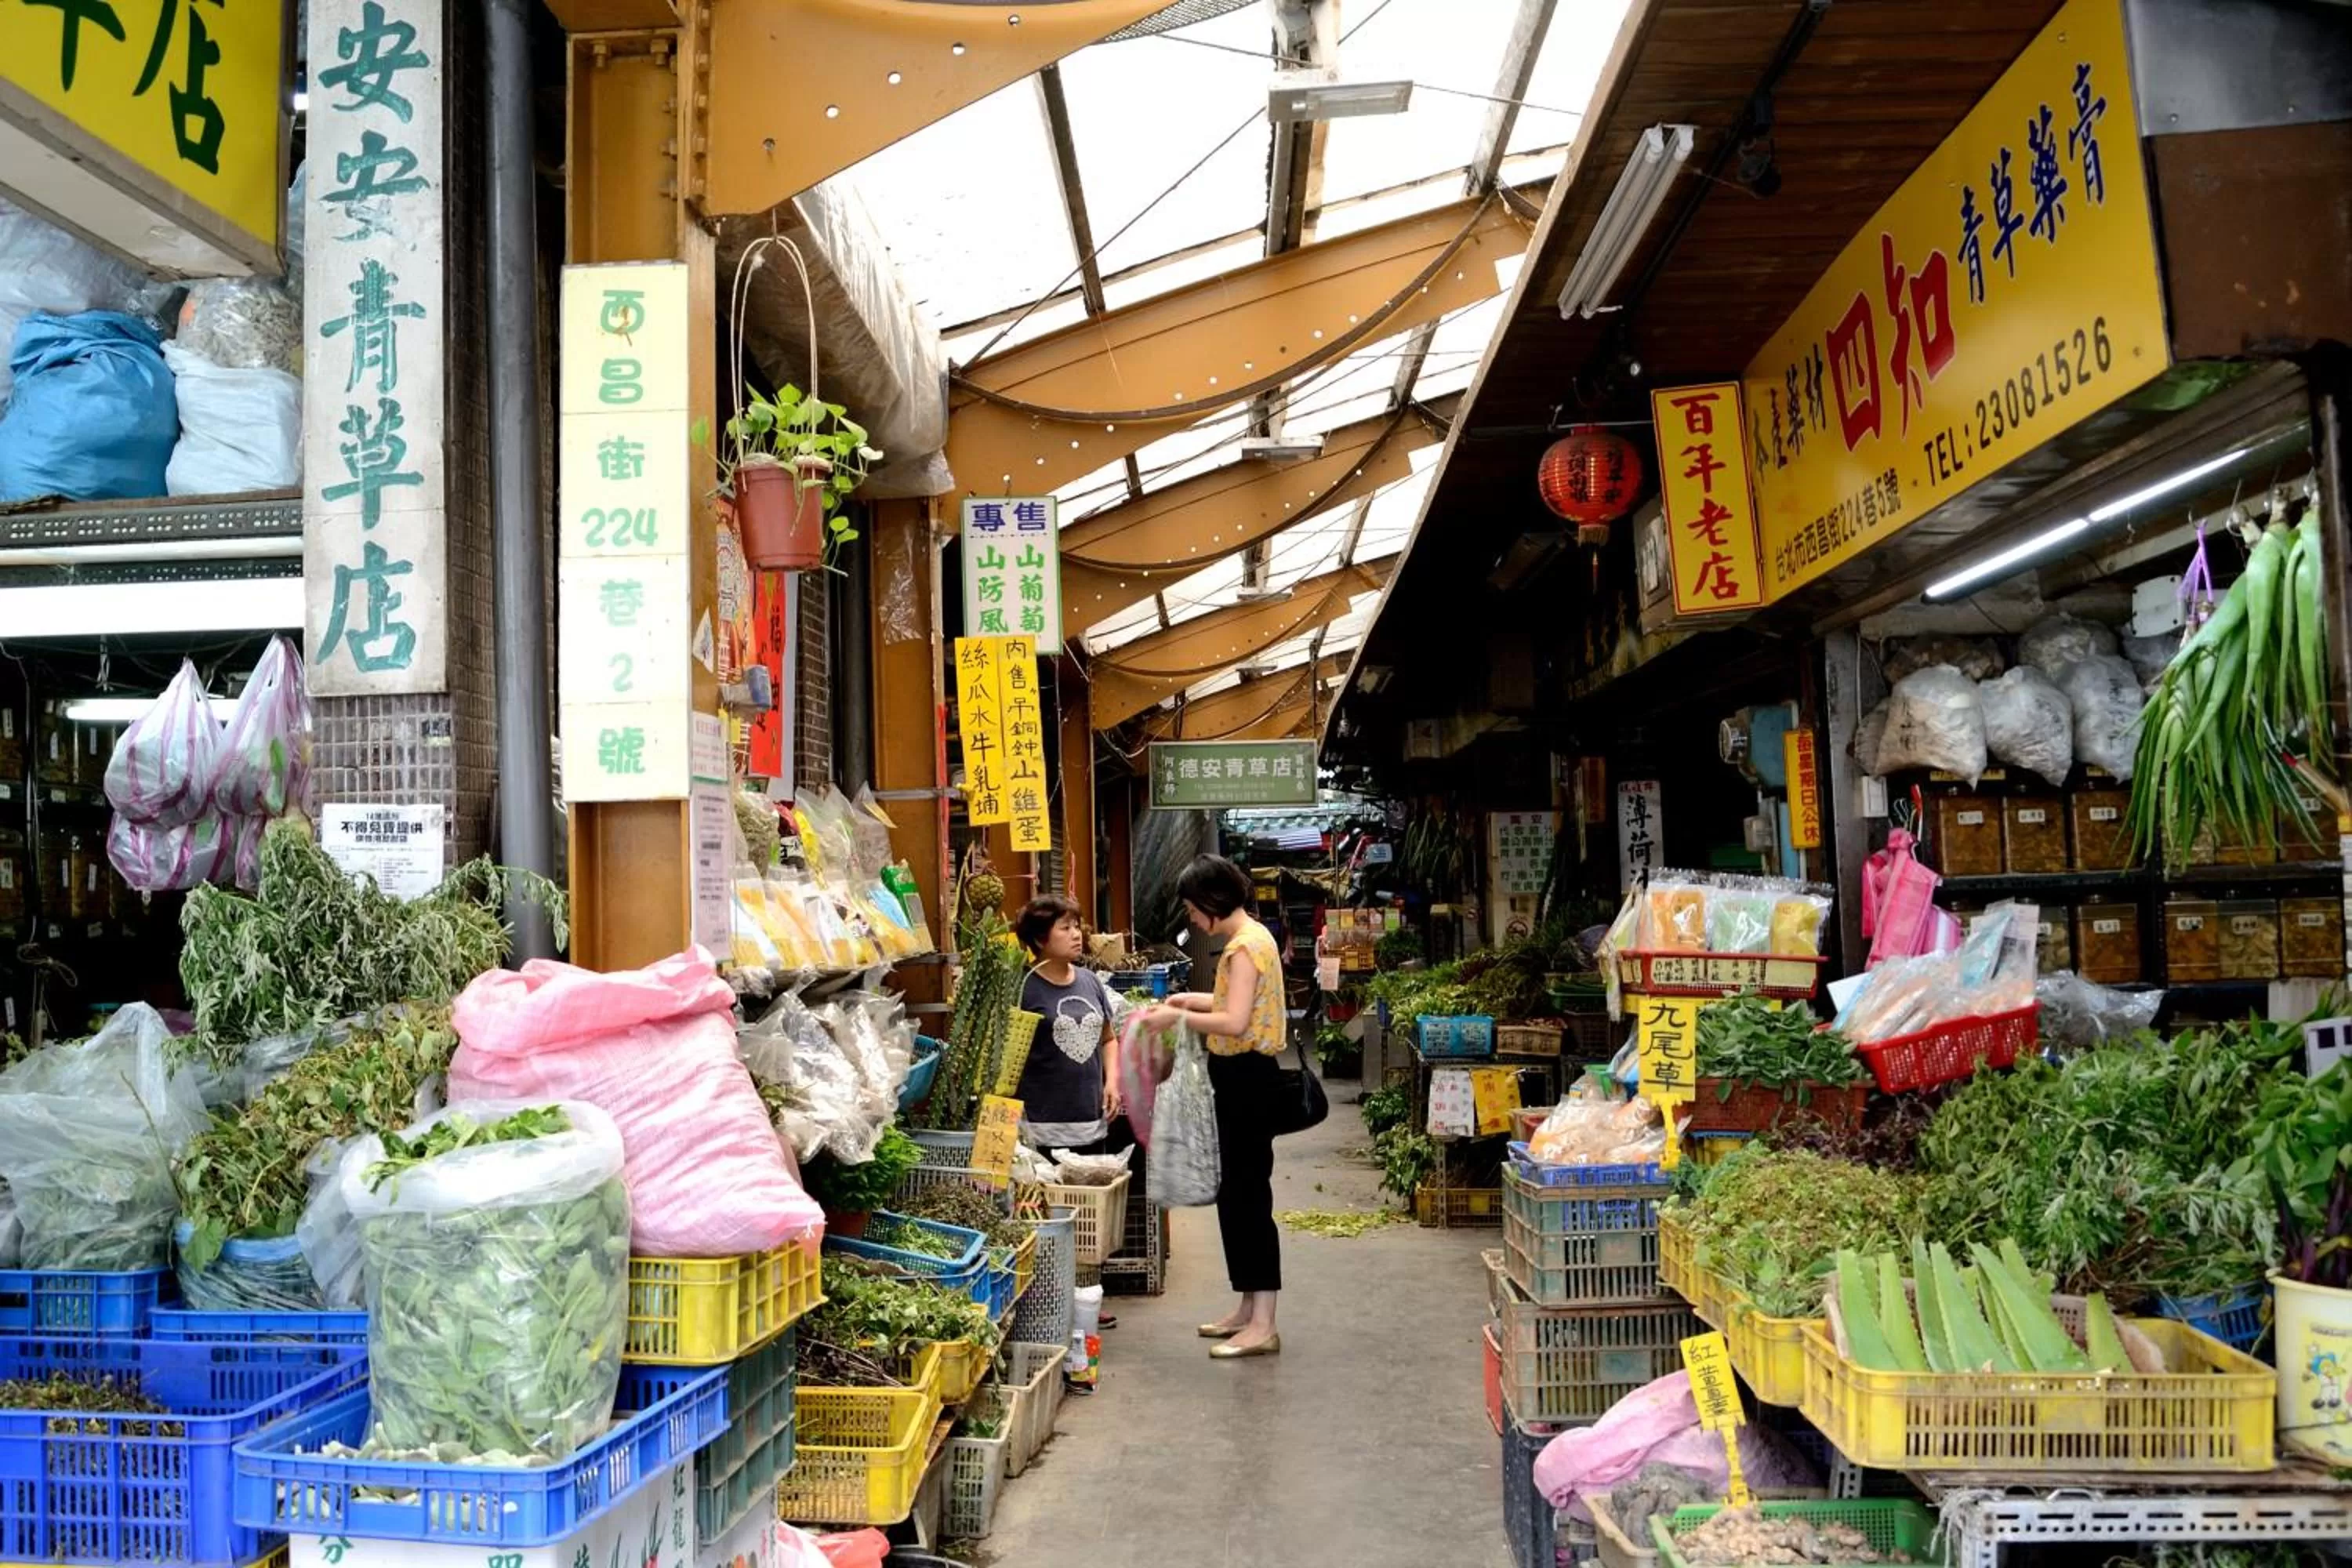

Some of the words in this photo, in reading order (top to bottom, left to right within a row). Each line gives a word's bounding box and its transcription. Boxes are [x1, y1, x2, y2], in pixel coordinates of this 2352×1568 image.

[1957, 63, 2107, 304] 青草藥膏
[1923, 315, 2112, 487] TEL:23081526
[971, 501, 1047, 532] 專售
[1670, 393, 1740, 601] 百年老店
[976, 545, 1009, 633] 山防風
[1016, 544, 1045, 633] 山葡萄
[1178, 757, 1292, 779] 德安青草店
[1641, 1002, 1695, 1092] 九尾草
